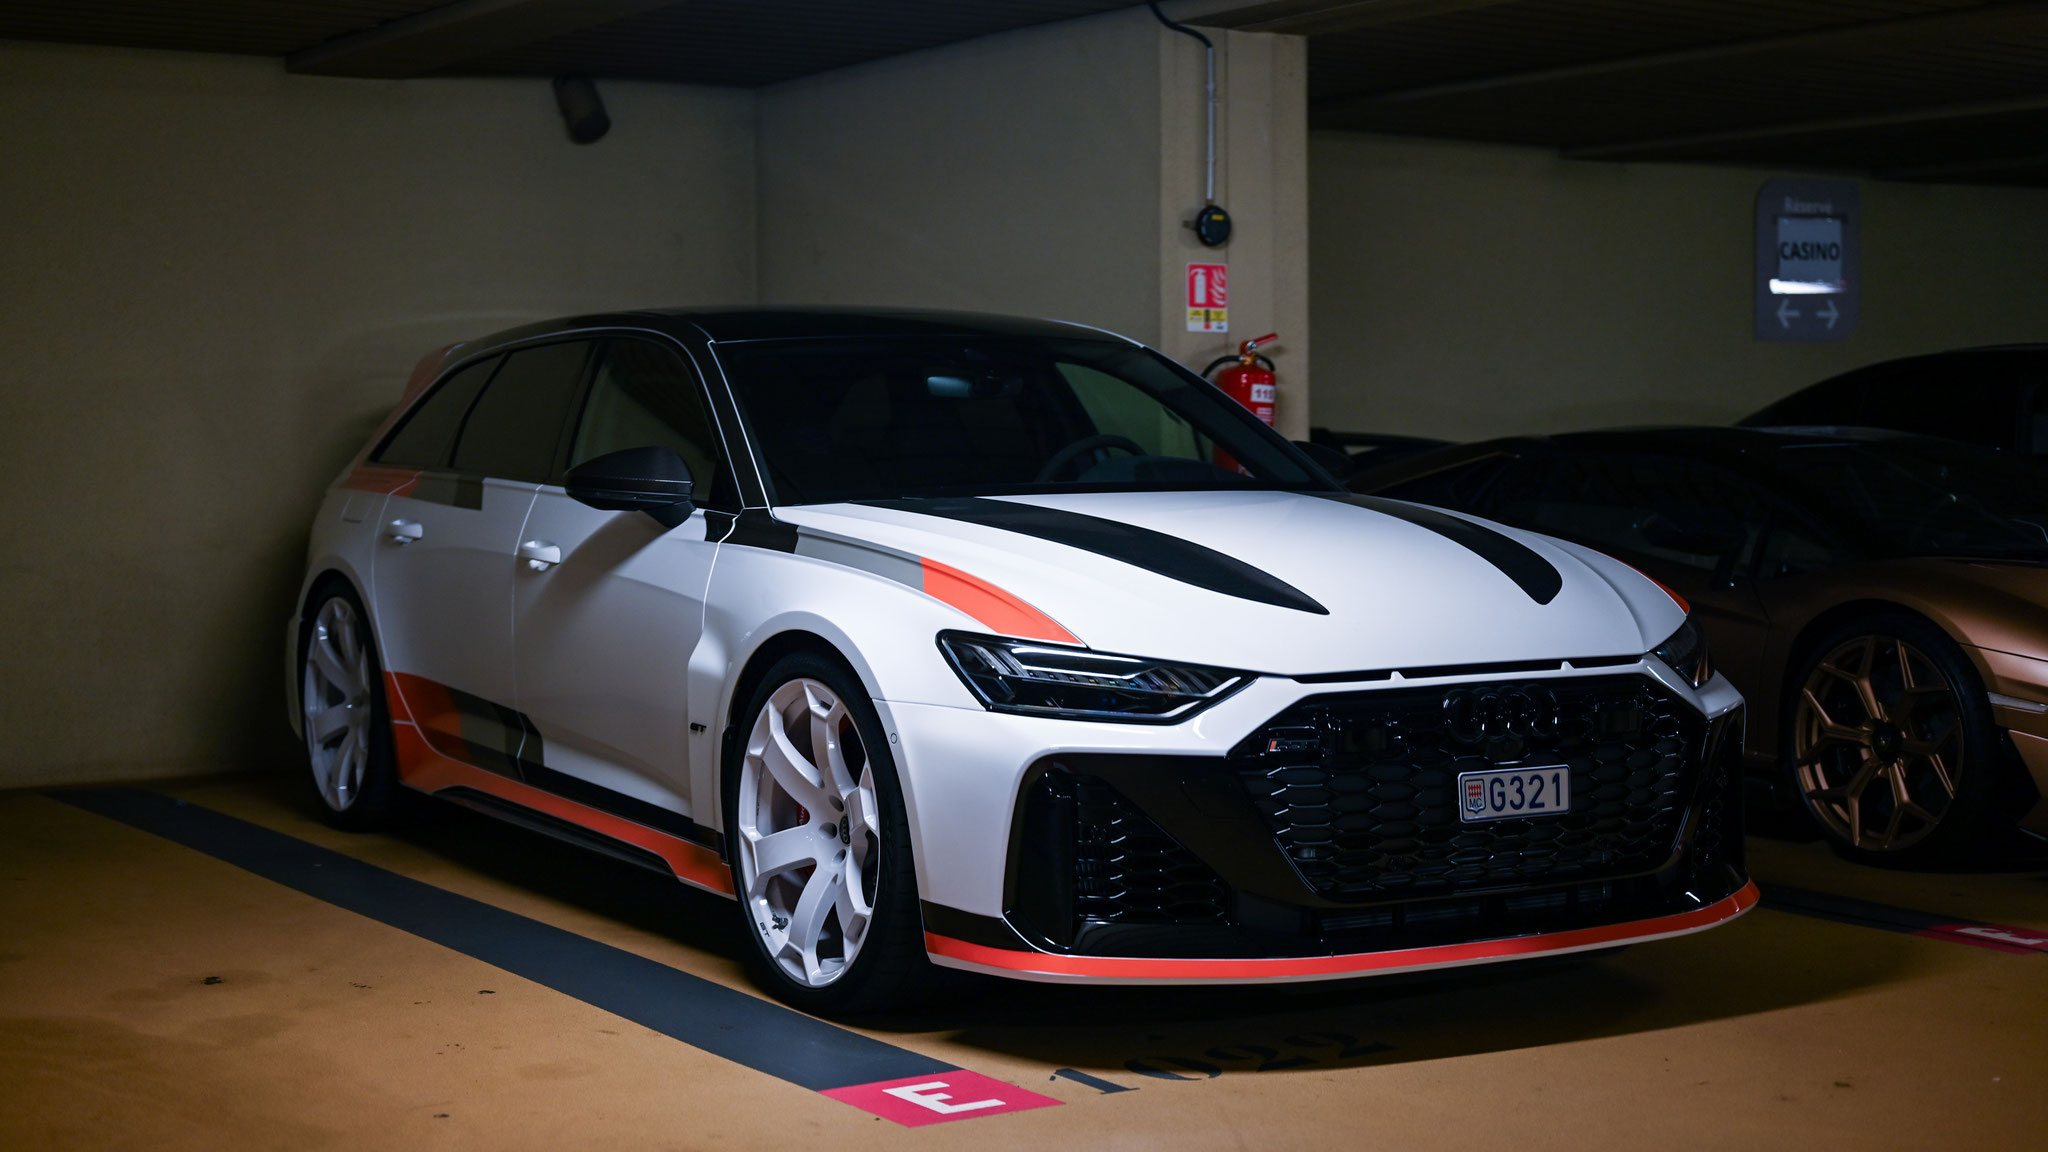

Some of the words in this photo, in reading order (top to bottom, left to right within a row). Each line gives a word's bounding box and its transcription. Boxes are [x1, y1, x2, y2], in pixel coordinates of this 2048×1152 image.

[1780, 242, 1840, 261] CASINO
[1469, 798, 1483, 808] MC
[1490, 773, 1561, 812] G321
[882, 1081, 1006, 1114] E
